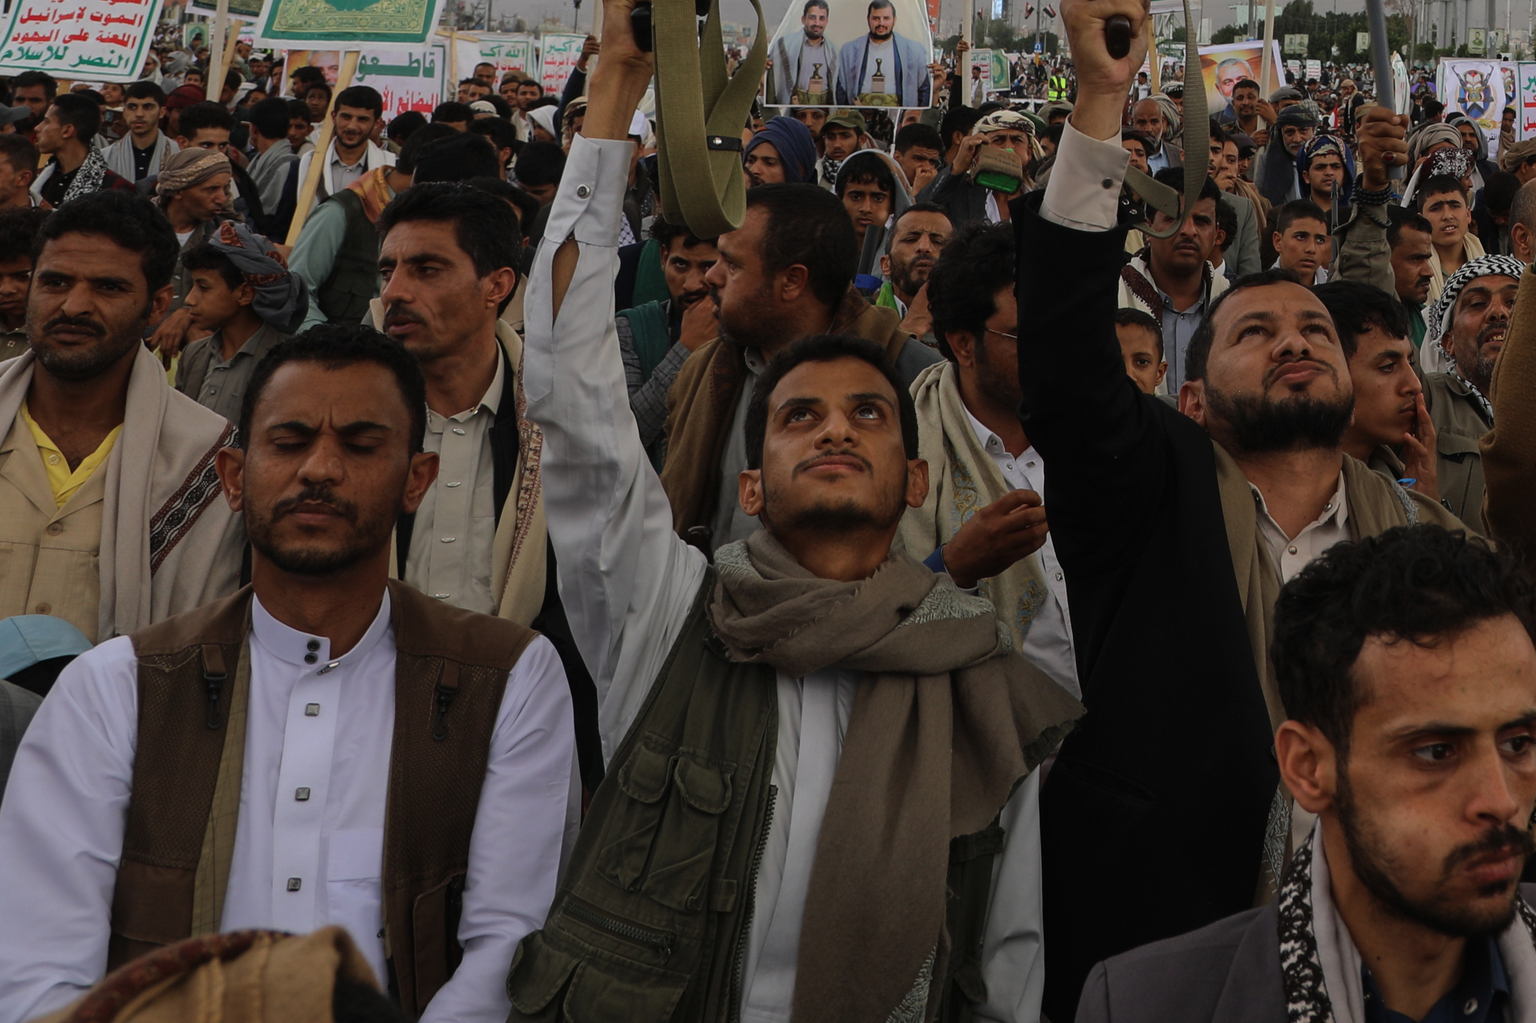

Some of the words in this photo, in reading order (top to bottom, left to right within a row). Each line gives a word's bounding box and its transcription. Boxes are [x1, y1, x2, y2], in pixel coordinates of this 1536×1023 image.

[19, 6, 87, 25] لإسرائيل
[90, 10, 144, 28] الموت
[11, 28, 60, 45] اليهود
[62, 27, 90, 45] على
[95, 29, 137, 50] اللعنة
[0, 45, 70, 67] للإسلام
[68, 48, 131, 70] النصر
[355, 51, 436, 83] قاطعو
